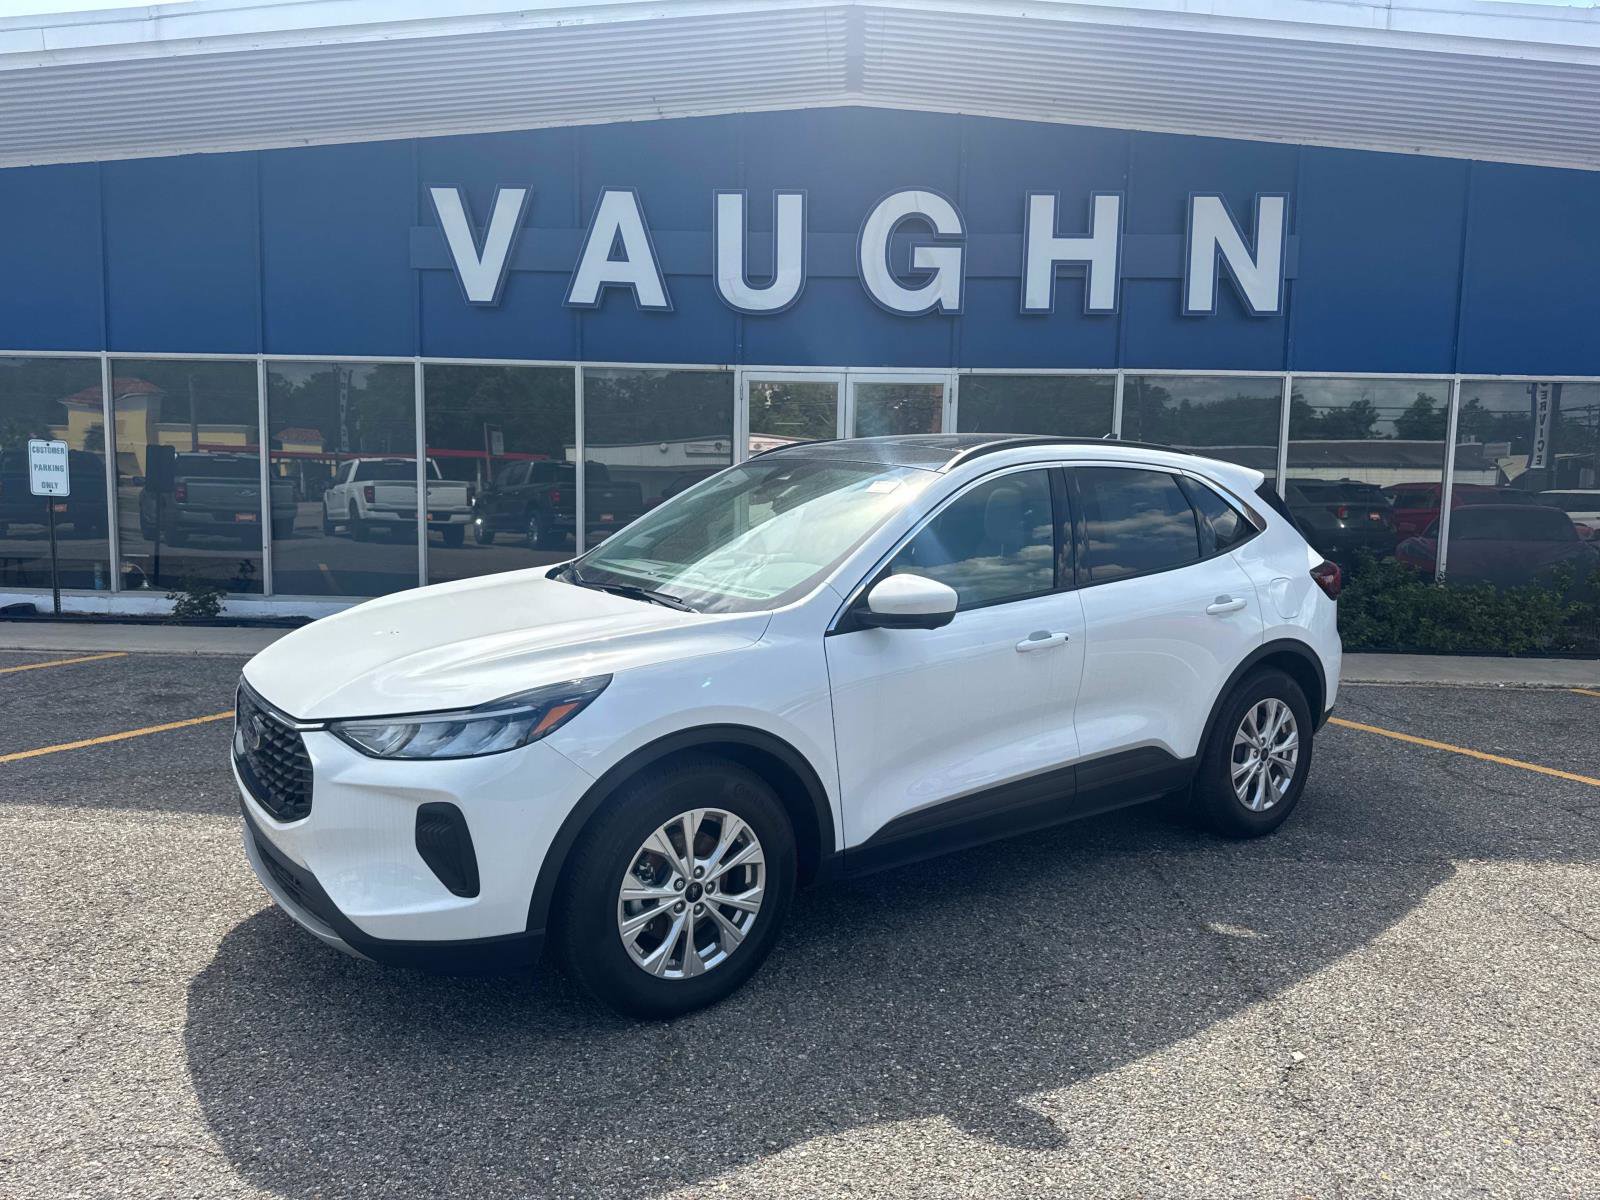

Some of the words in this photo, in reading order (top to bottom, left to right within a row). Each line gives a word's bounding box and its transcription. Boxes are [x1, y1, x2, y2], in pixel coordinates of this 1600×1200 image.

[430, 187, 1285, 313] VAUGHN
[32, 446, 65, 455] CUSTOMER
[33, 464, 65, 473] PARKING
[41, 481, 59, 489] ONLY
